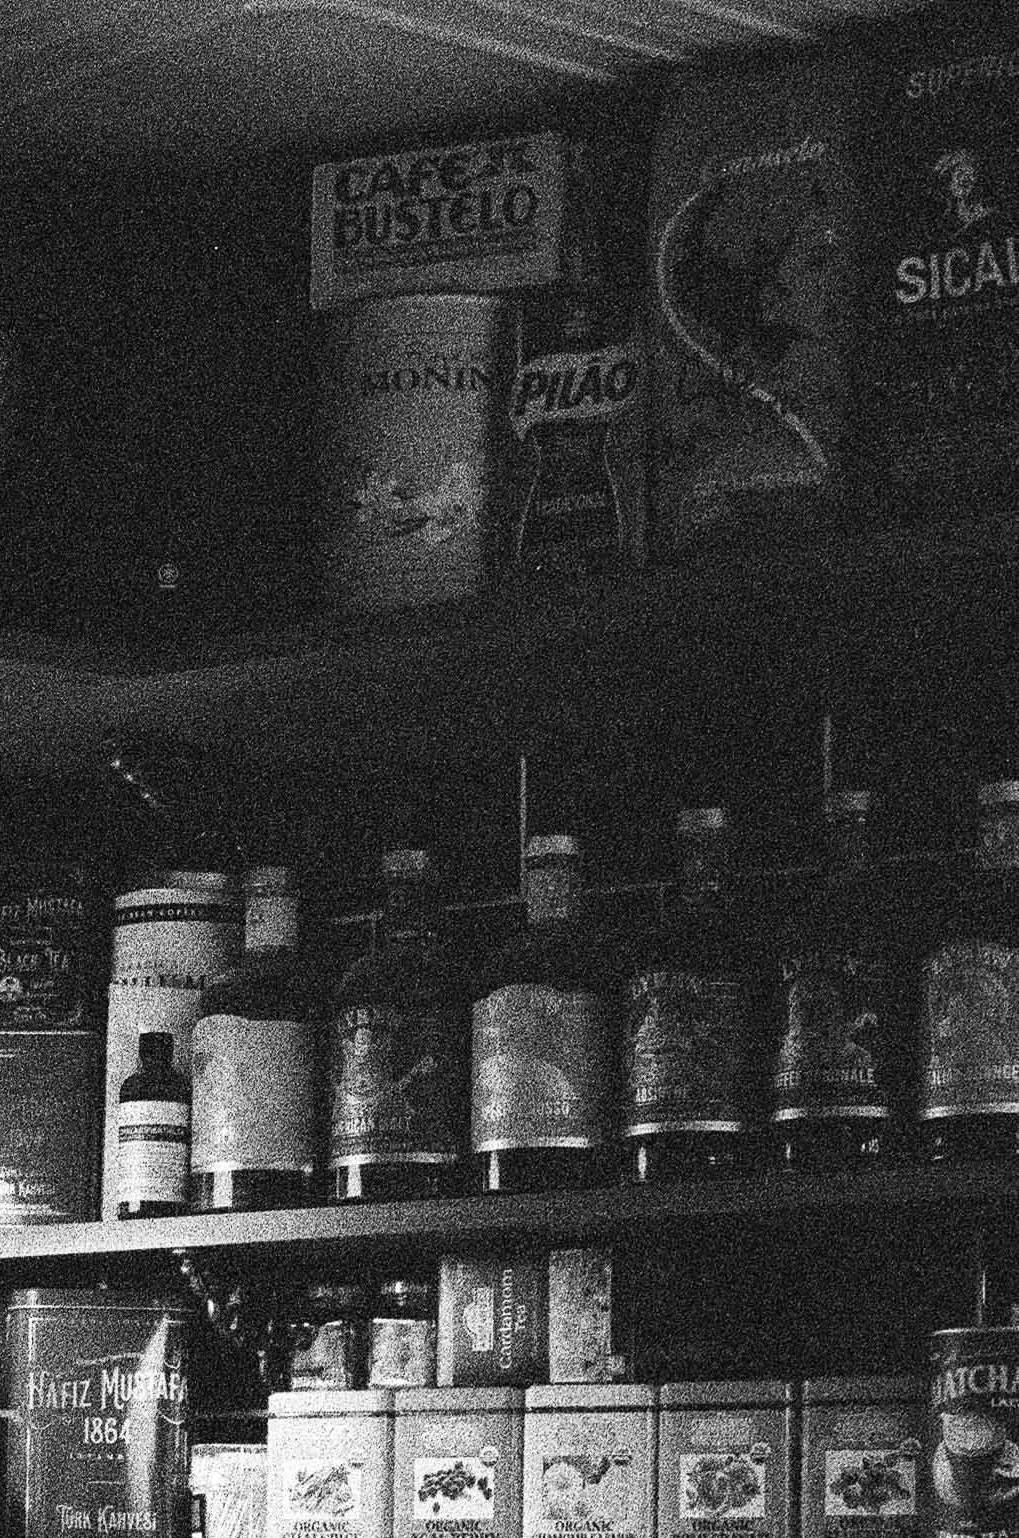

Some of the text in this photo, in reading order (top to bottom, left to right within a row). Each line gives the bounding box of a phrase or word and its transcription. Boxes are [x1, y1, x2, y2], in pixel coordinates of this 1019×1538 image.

[334, 185, 538, 248] BUSTELO
[363, 362, 492, 397] MONIN
[498, 1267, 514, 1370] Cardamom
[515, 1304, 528, 1333] Tea
[27, 1370, 92, 1410] HAFIZ
[83, 1417, 132, 1445] 1864
[293, 1519, 350, 1533] ORGANIC
[425, 1519, 482, 1533] ORGANIC
[554, 1519, 615, 1532] ORGANIC
